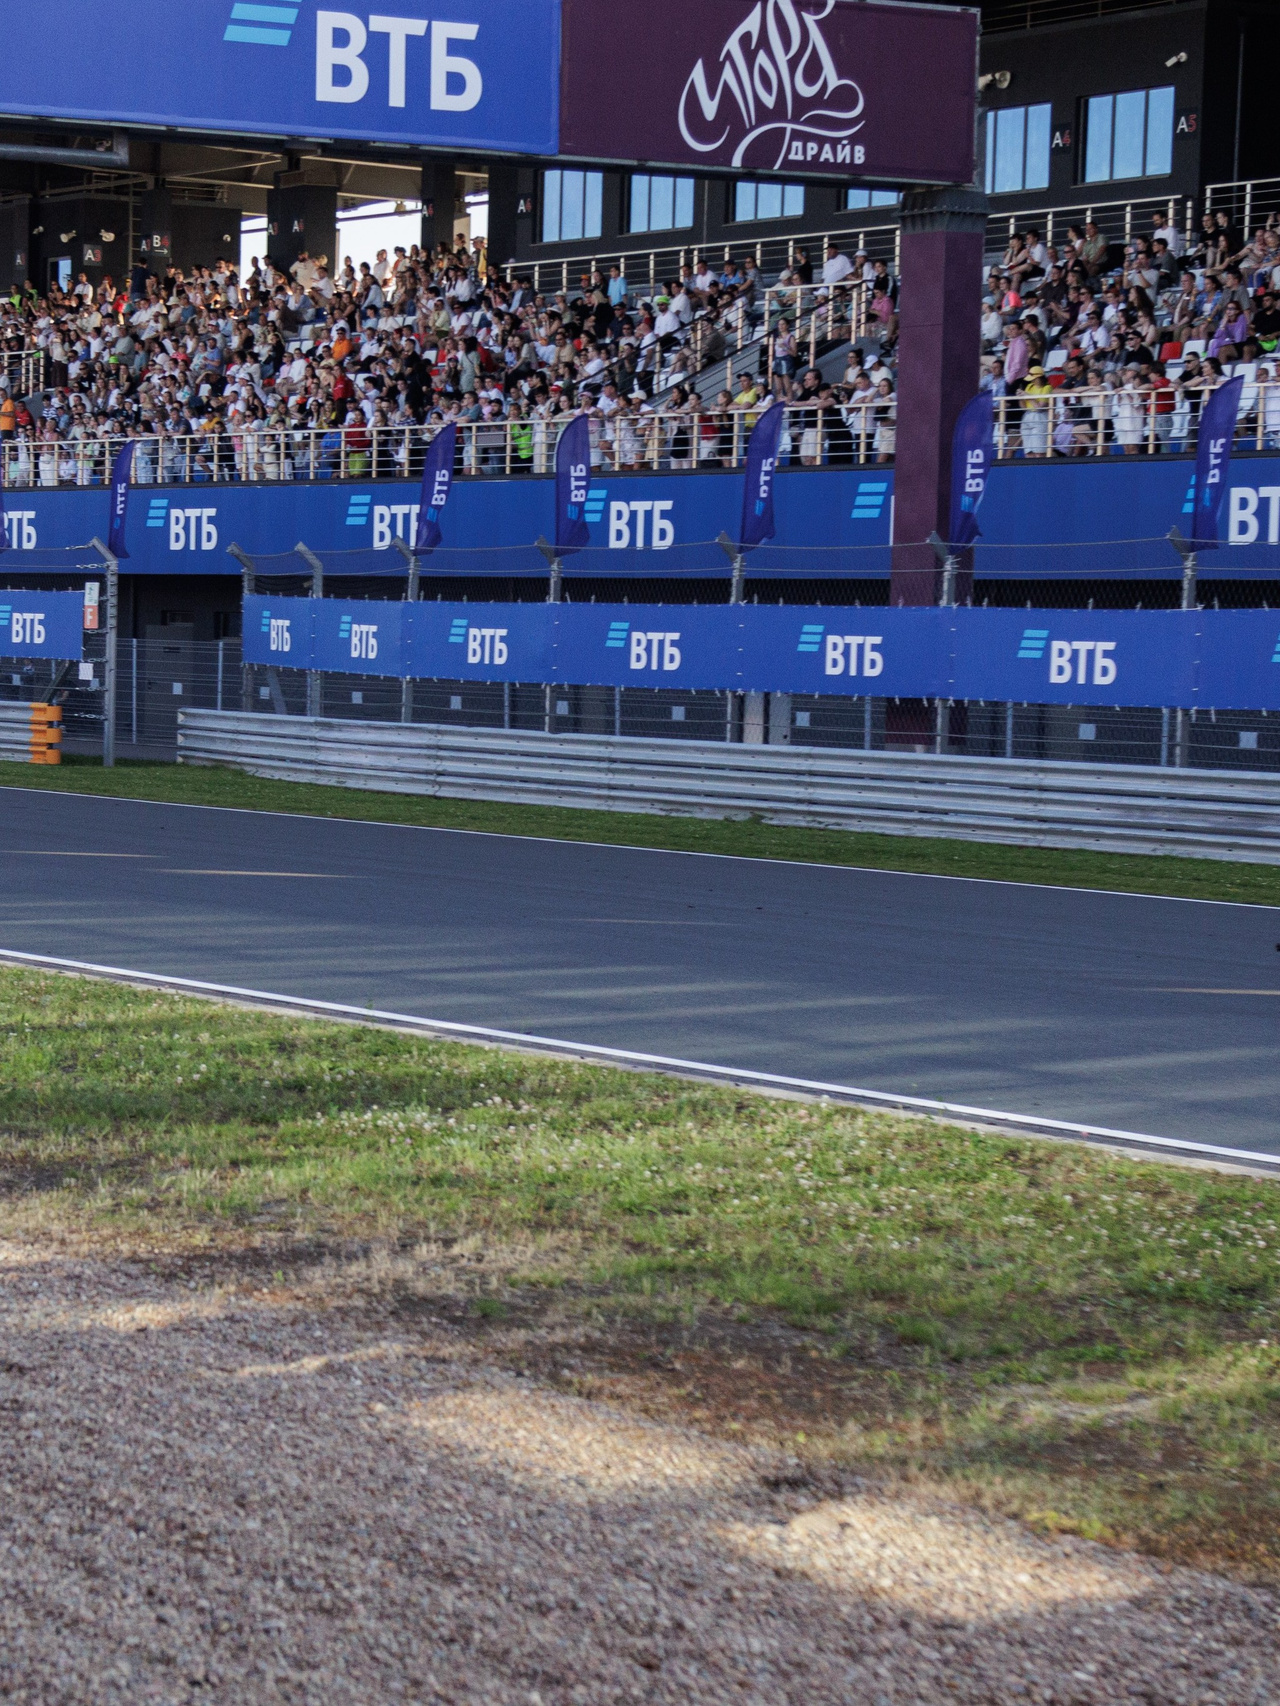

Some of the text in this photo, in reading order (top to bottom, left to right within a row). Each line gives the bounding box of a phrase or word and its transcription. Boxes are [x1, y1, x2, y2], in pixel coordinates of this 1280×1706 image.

[315, 10, 483, 111] ВТБ
[788, 139, 866, 165] ДРАЙВ
[84, 249, 102, 263] A3
[431, 468, 449, 506] ВТБ
[570, 463, 587, 502] ВТБ
[964, 448, 985, 493] ВТБ
[170, 508, 218, 551] ВТБ
[609, 500, 675, 550] ВТБ
[1228, 486, 1280, 546] ВТ
[11, 613, 45, 644] ВТБ
[270, 618, 291, 652] ВТБ
[350, 623, 378, 659] ВТБ
[467, 627, 509, 665] ВТБ
[629, 630, 682, 671] ВТБ
[824, 634, 884, 677] ВТБ
[1048, 640, 1117, 686] ВТБ
